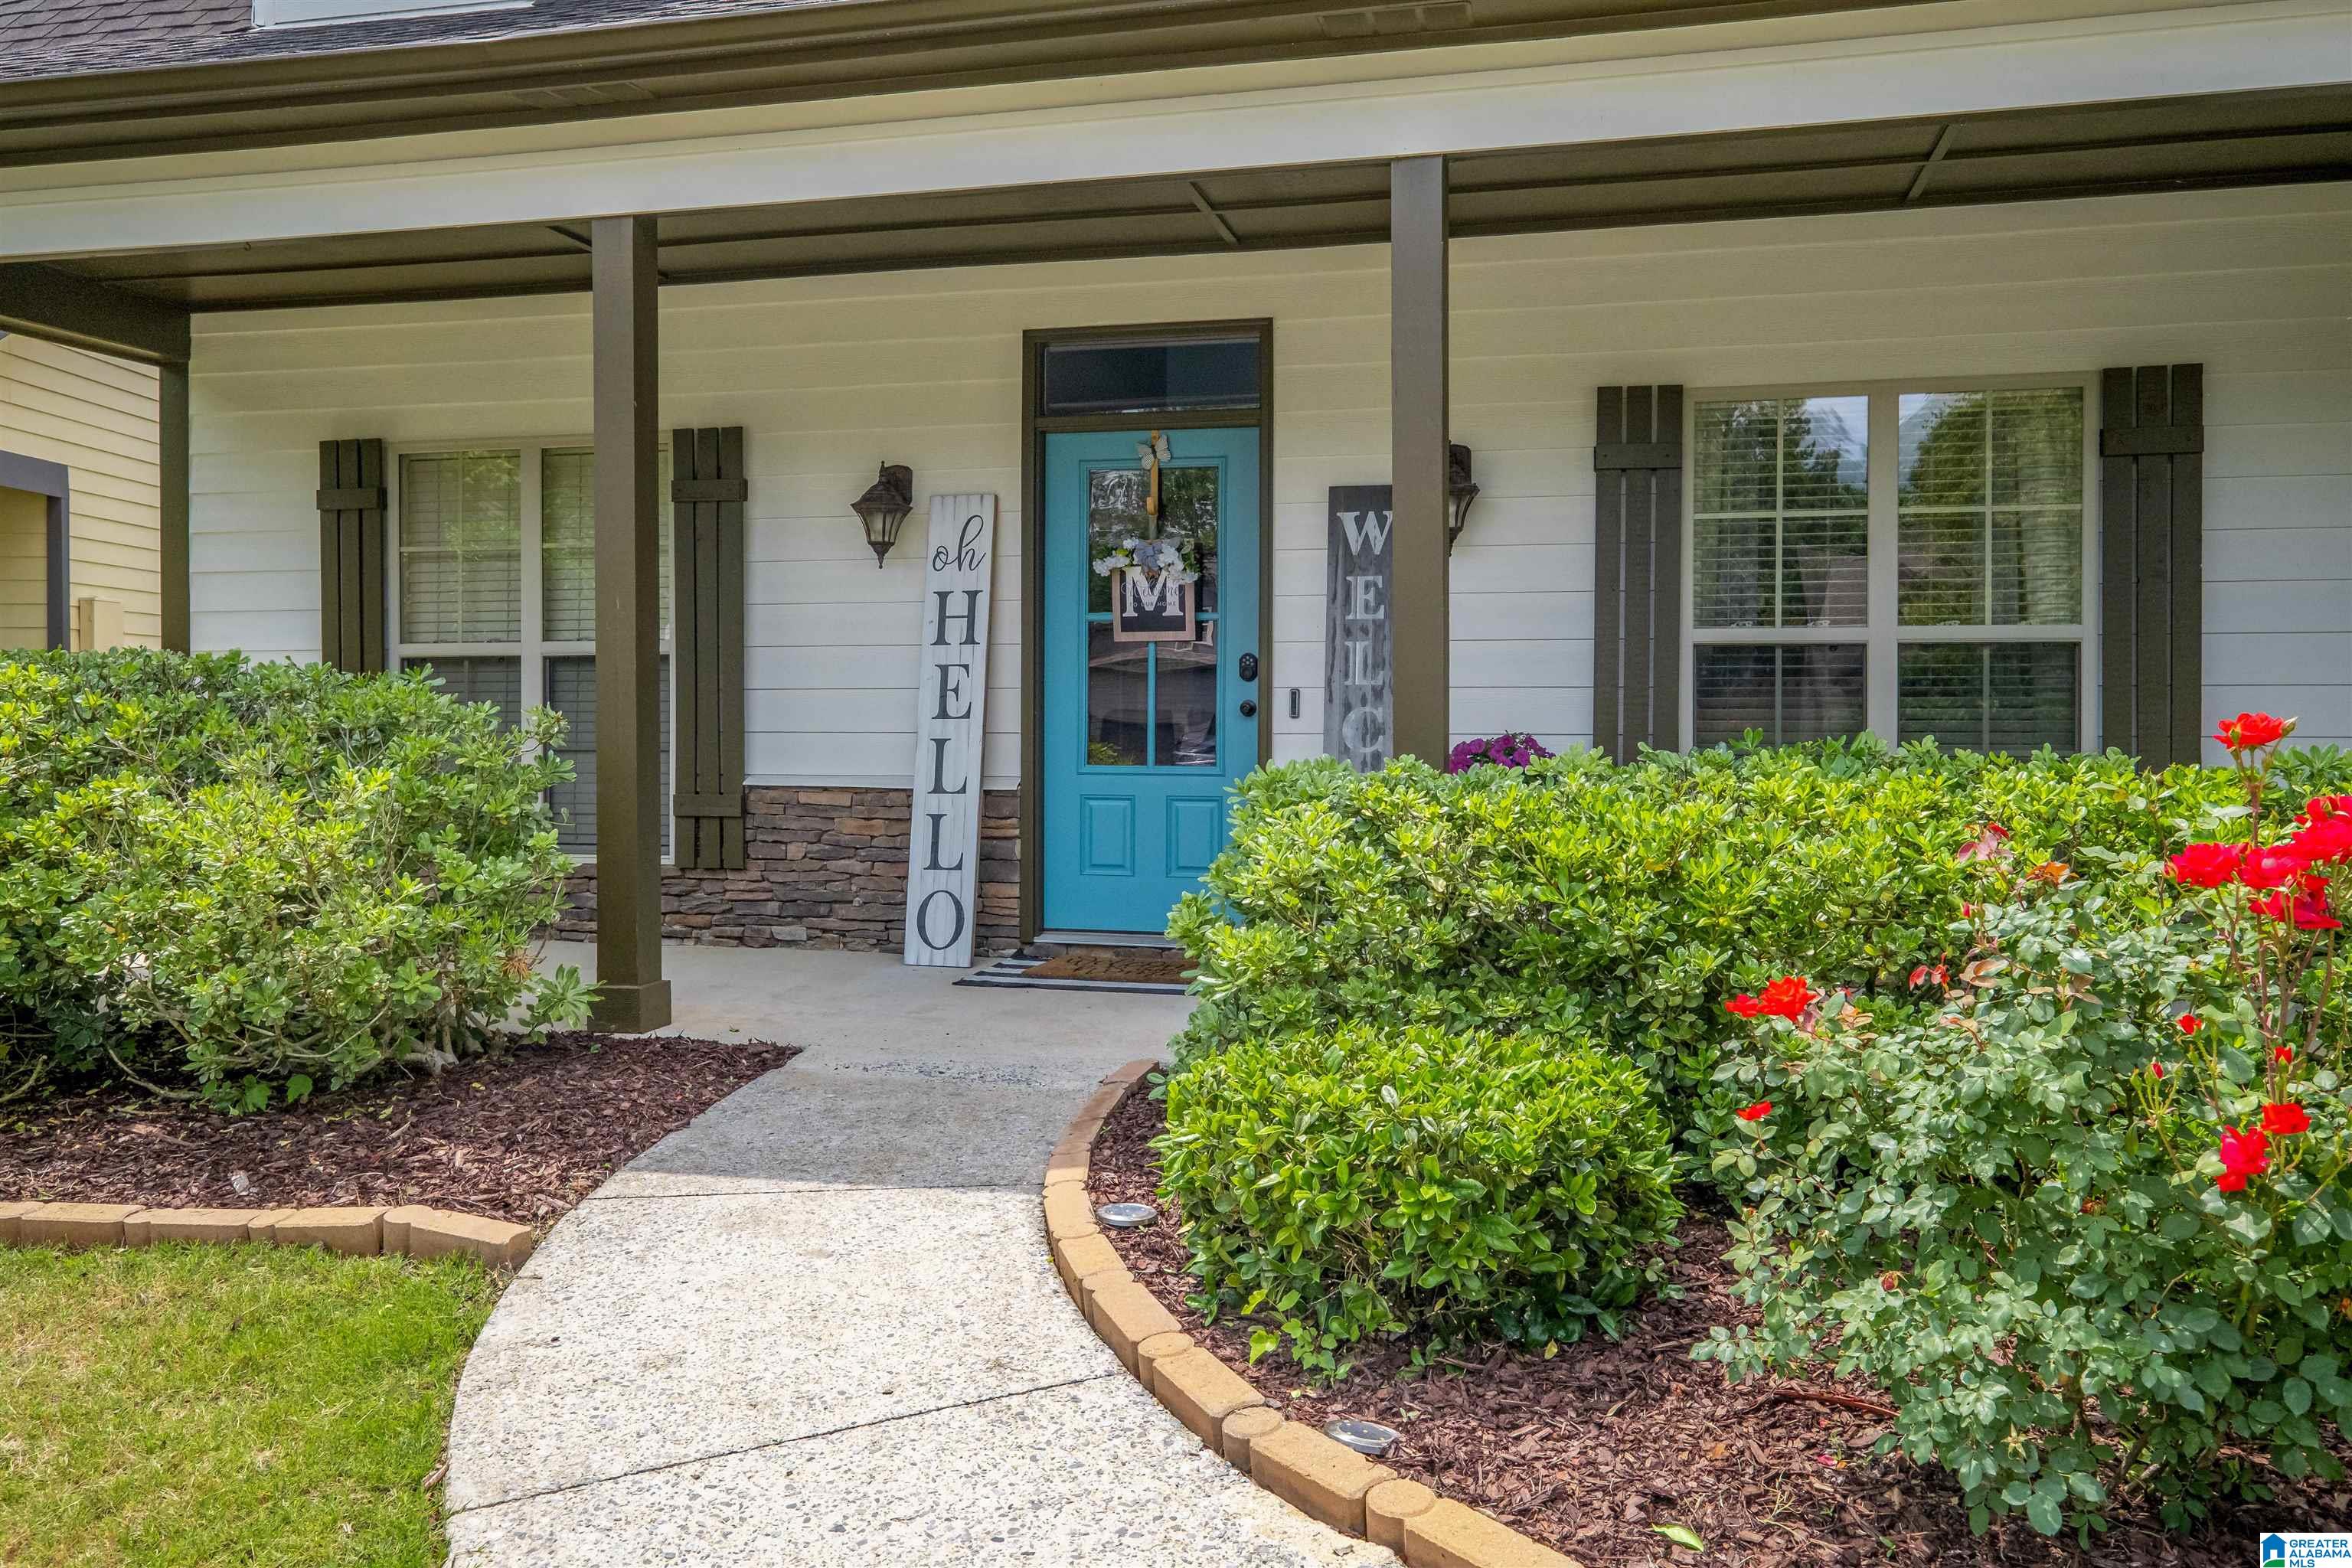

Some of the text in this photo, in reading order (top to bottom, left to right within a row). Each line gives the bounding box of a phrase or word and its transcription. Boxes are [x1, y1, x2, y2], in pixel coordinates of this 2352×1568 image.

[932, 514, 986, 572] oh
[1122, 566, 1184, 617] M
[916, 590, 984, 951] HELLO
